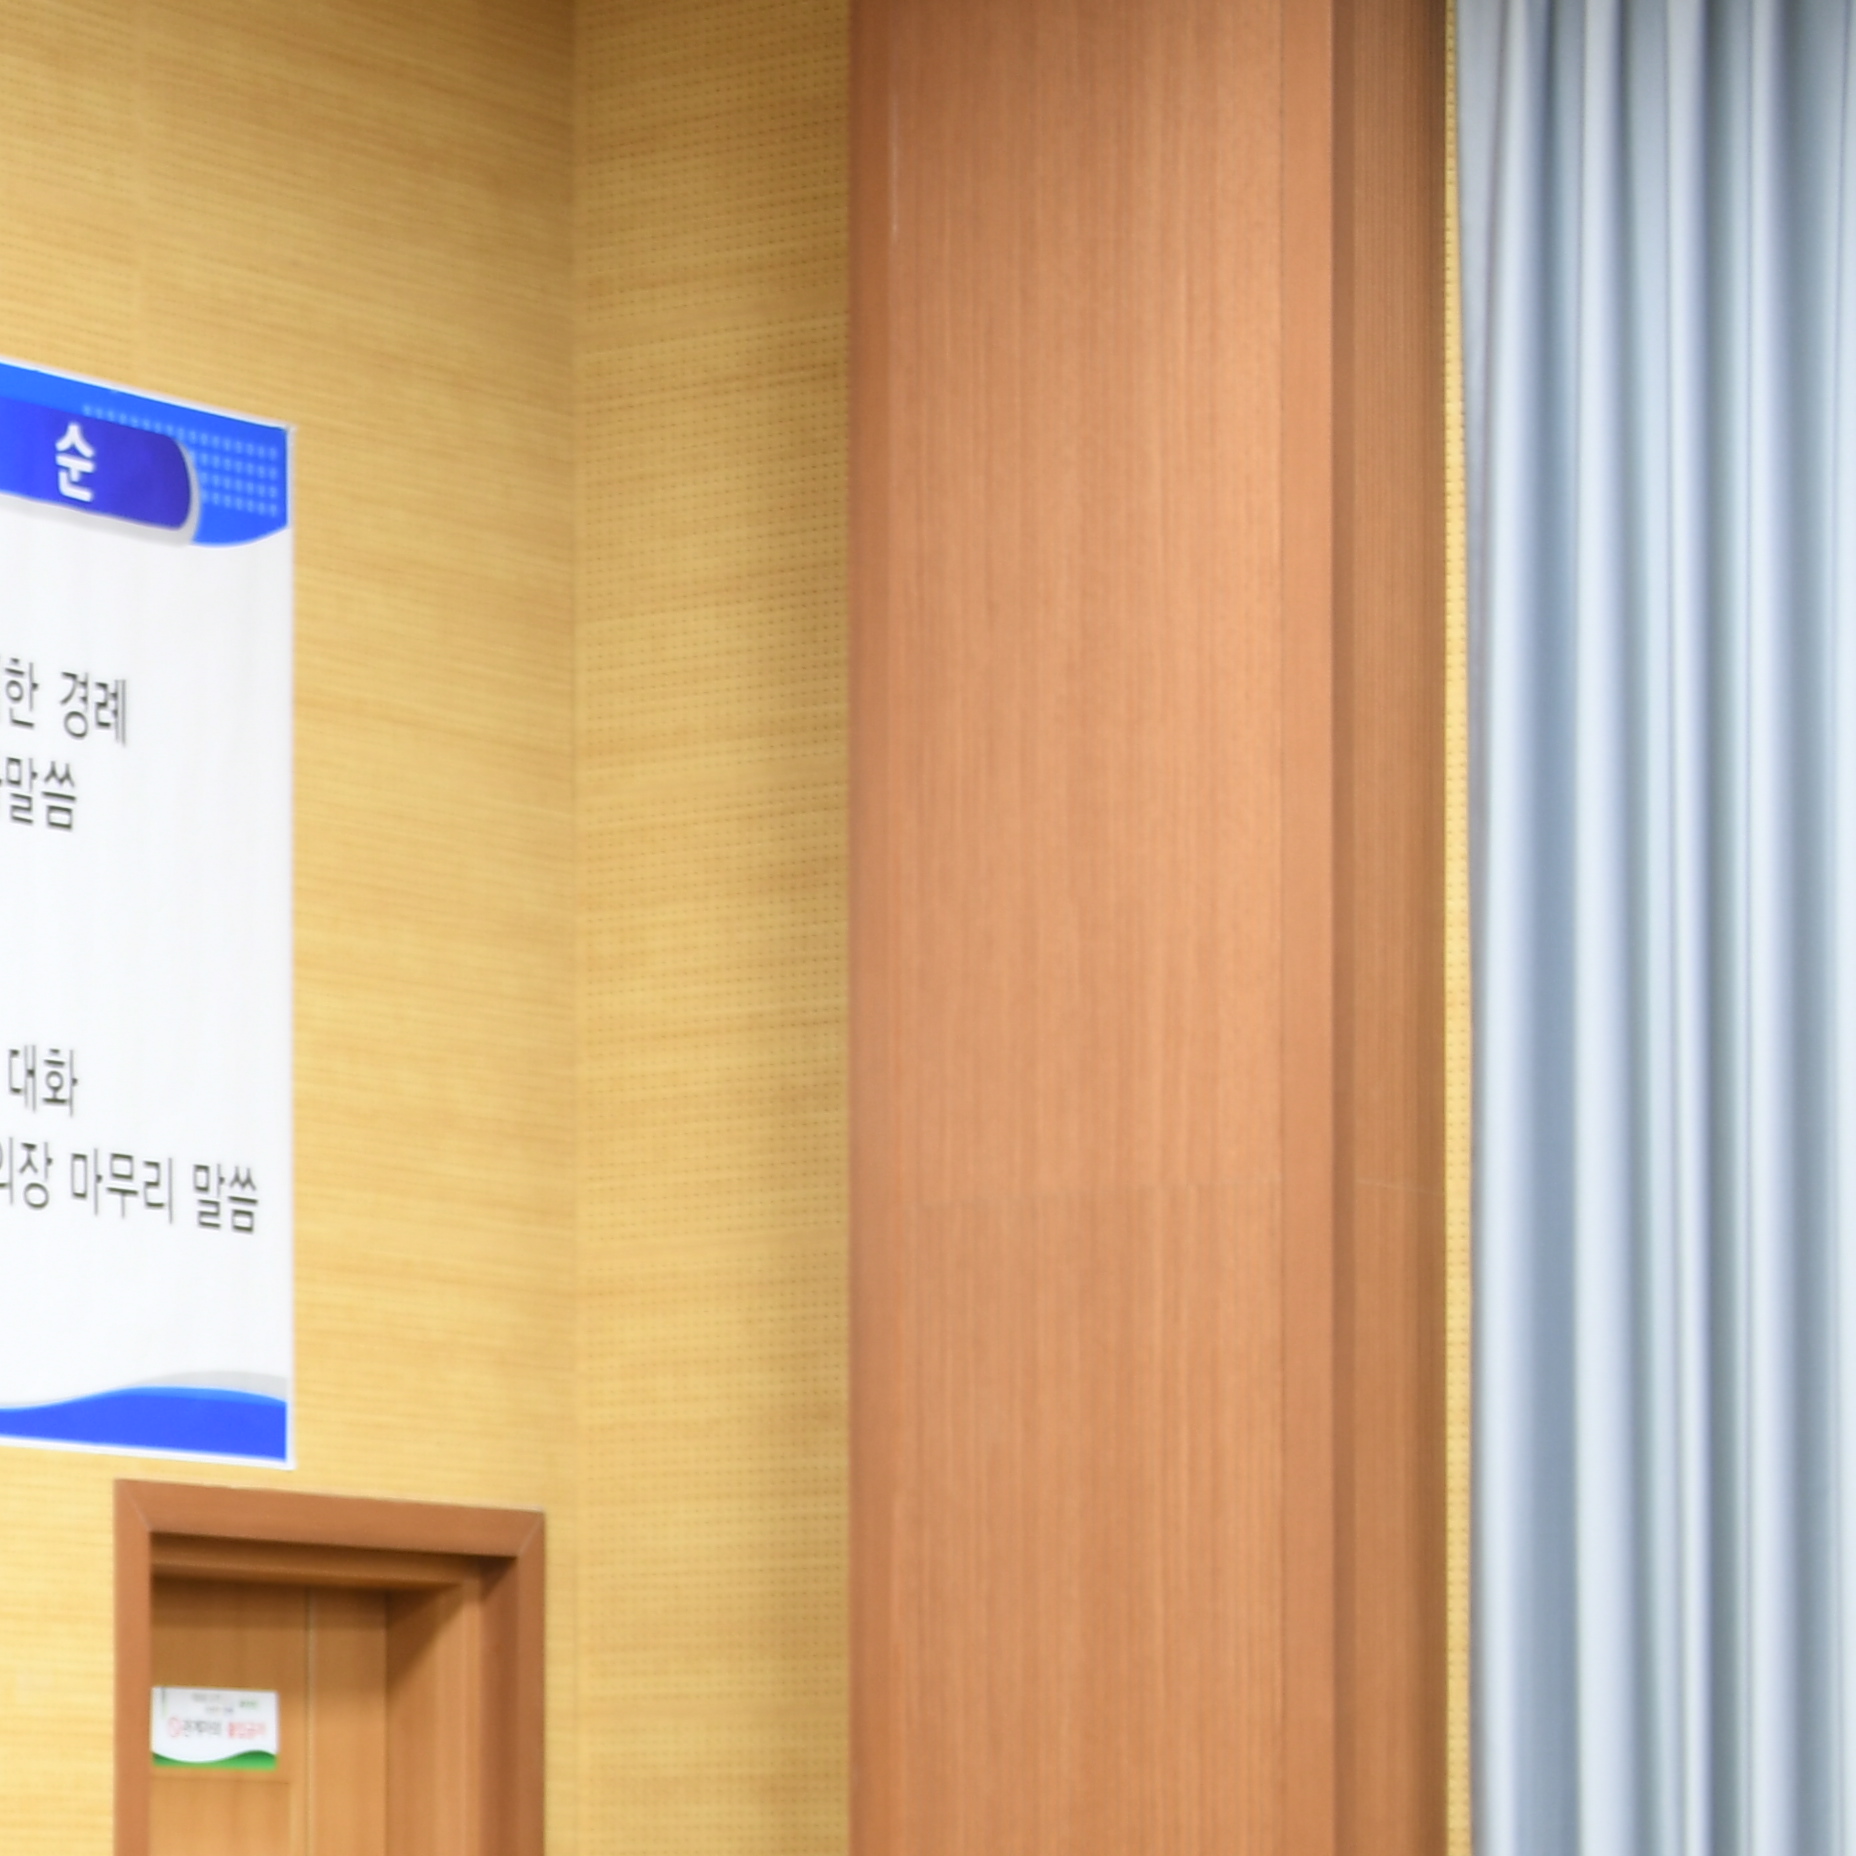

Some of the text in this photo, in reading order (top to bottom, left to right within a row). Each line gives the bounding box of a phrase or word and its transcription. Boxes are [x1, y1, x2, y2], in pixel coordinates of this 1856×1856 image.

[55, 422, 96, 503] 순
[59, 669, 127, 747] 경례
[8, 1043, 79, 1118] 대화
[70, 1147, 175, 1226] 마무리
[193, 1161, 260, 1235] 말씀
